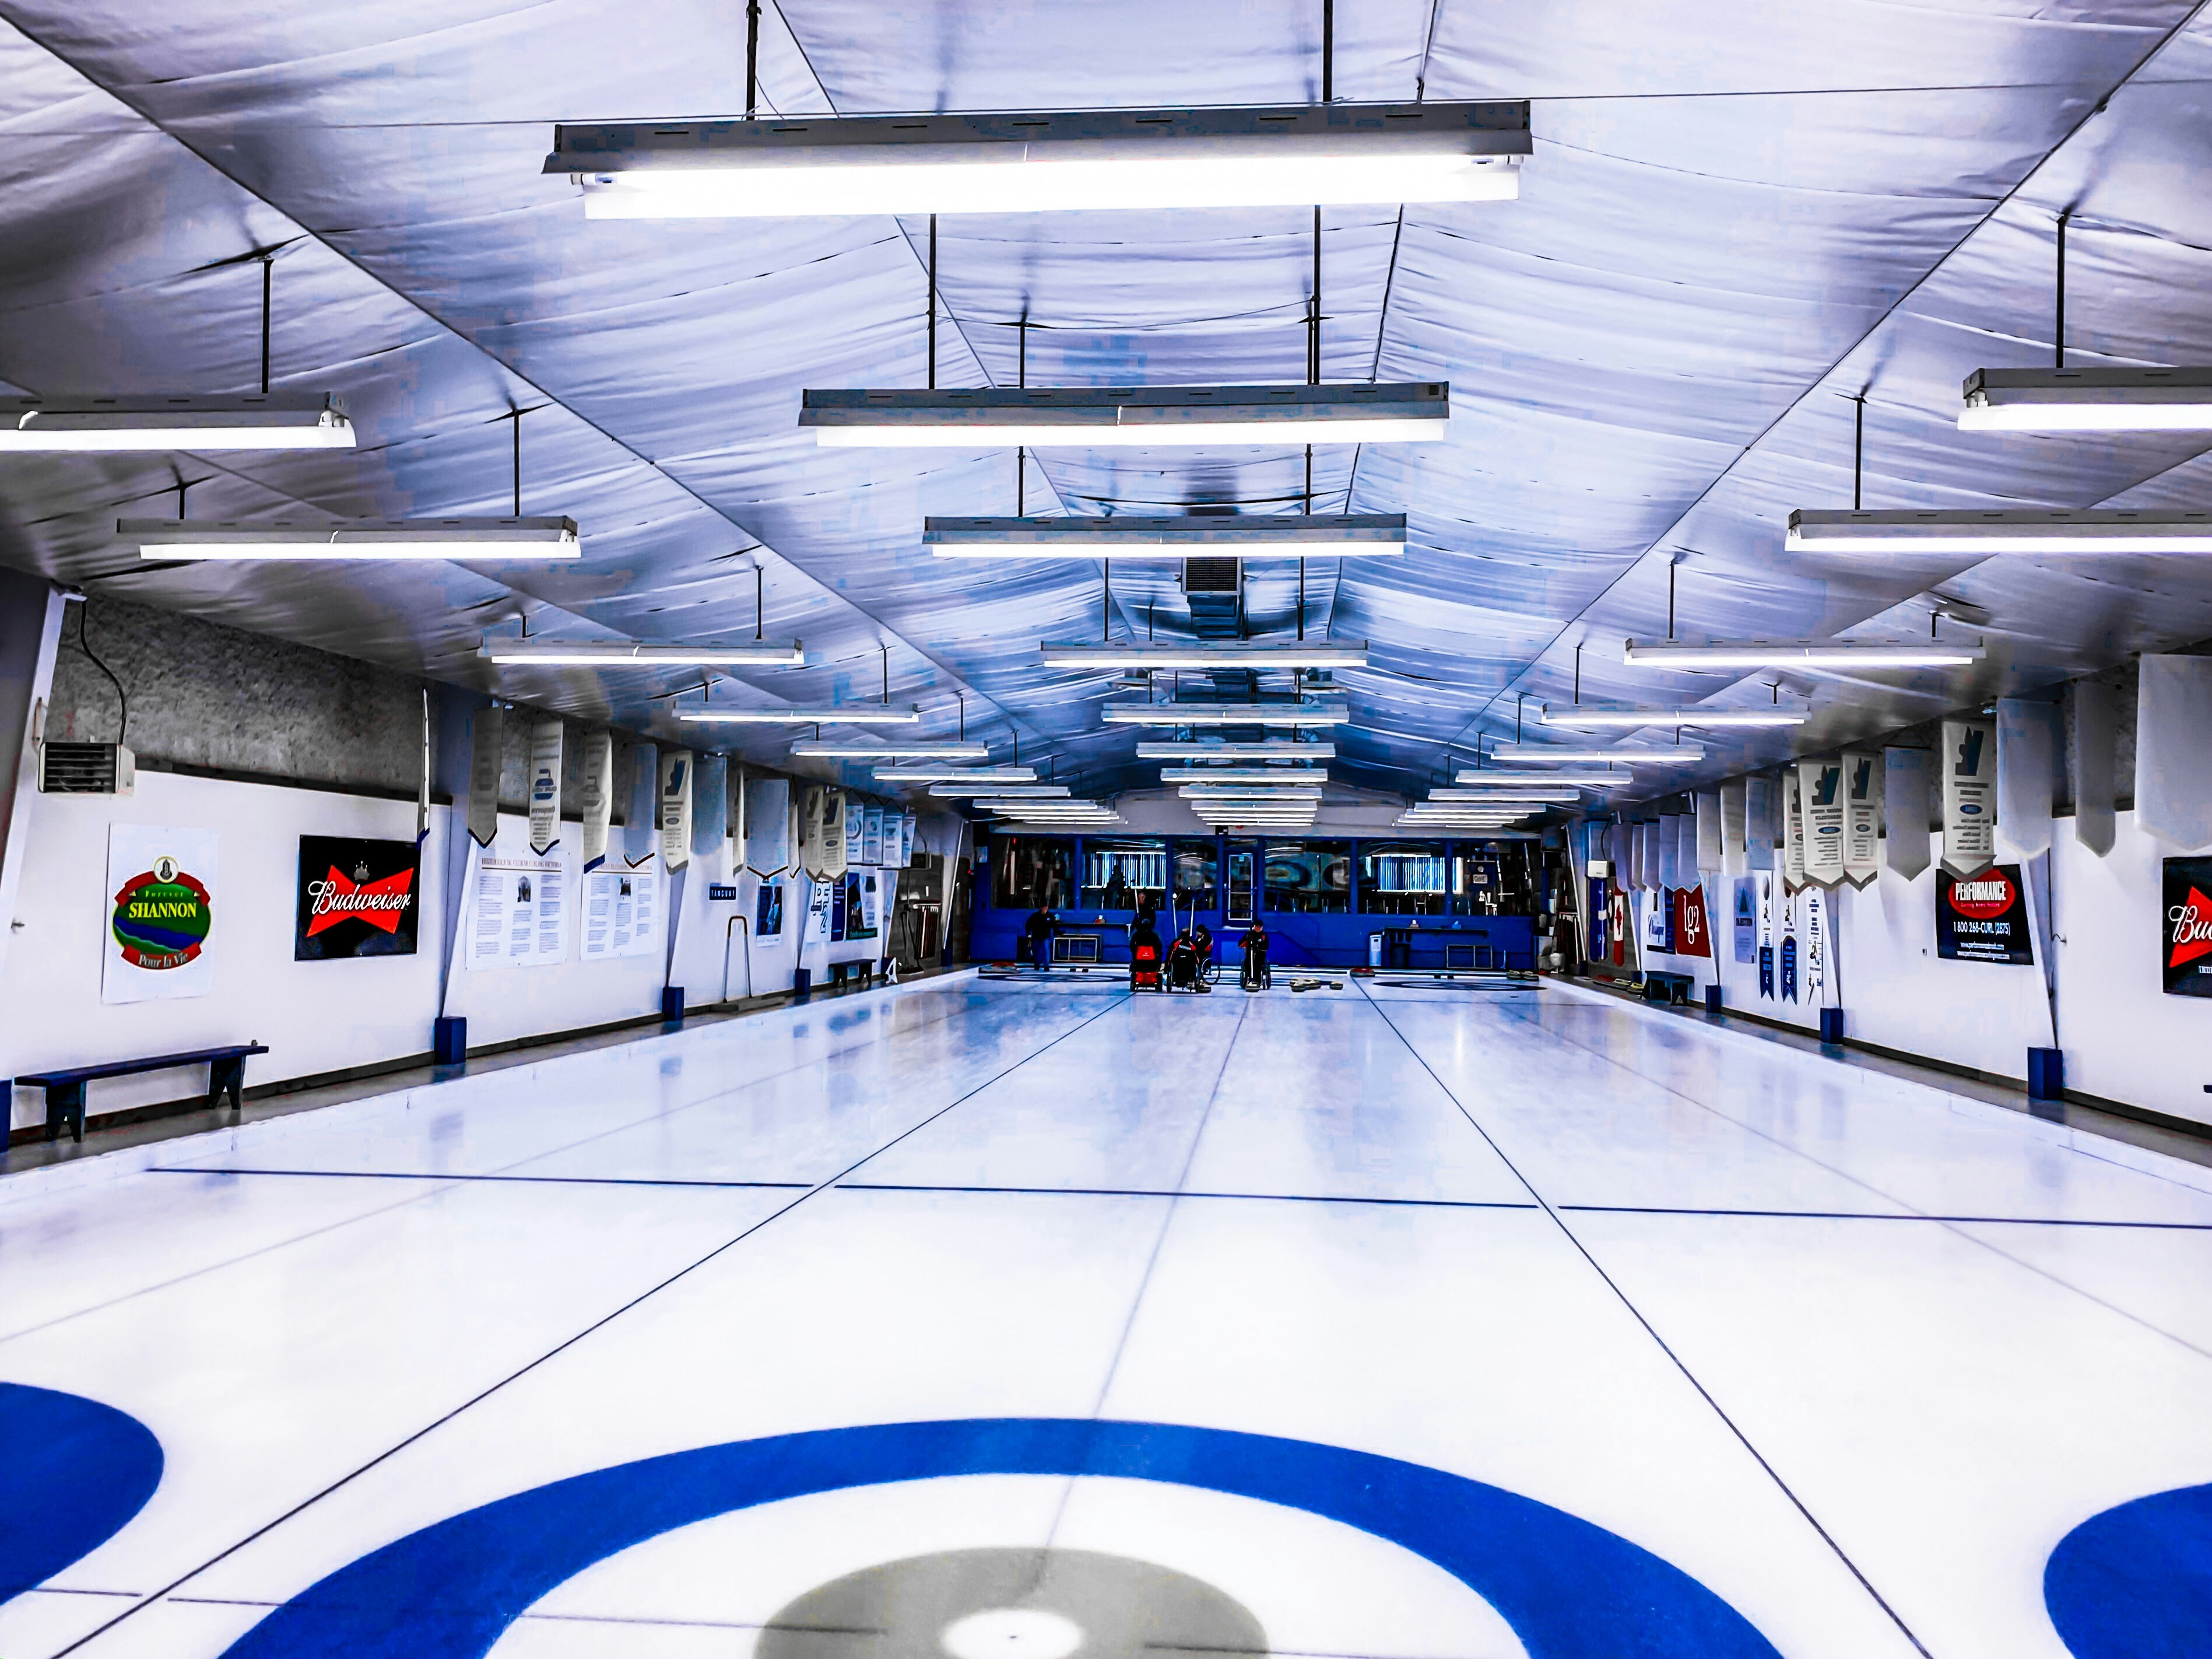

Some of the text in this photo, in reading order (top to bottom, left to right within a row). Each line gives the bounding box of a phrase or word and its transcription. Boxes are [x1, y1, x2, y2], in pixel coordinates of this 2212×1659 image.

[308, 881, 411, 914] Budweiser
[1955, 881, 2006, 901] PERFORMANCE
[129, 902, 196, 918] SHANNON
[1683, 895, 1700, 945] lg2
[1957, 921, 1968, 932] 800
[139, 951, 188, 967] Pour la Vie
